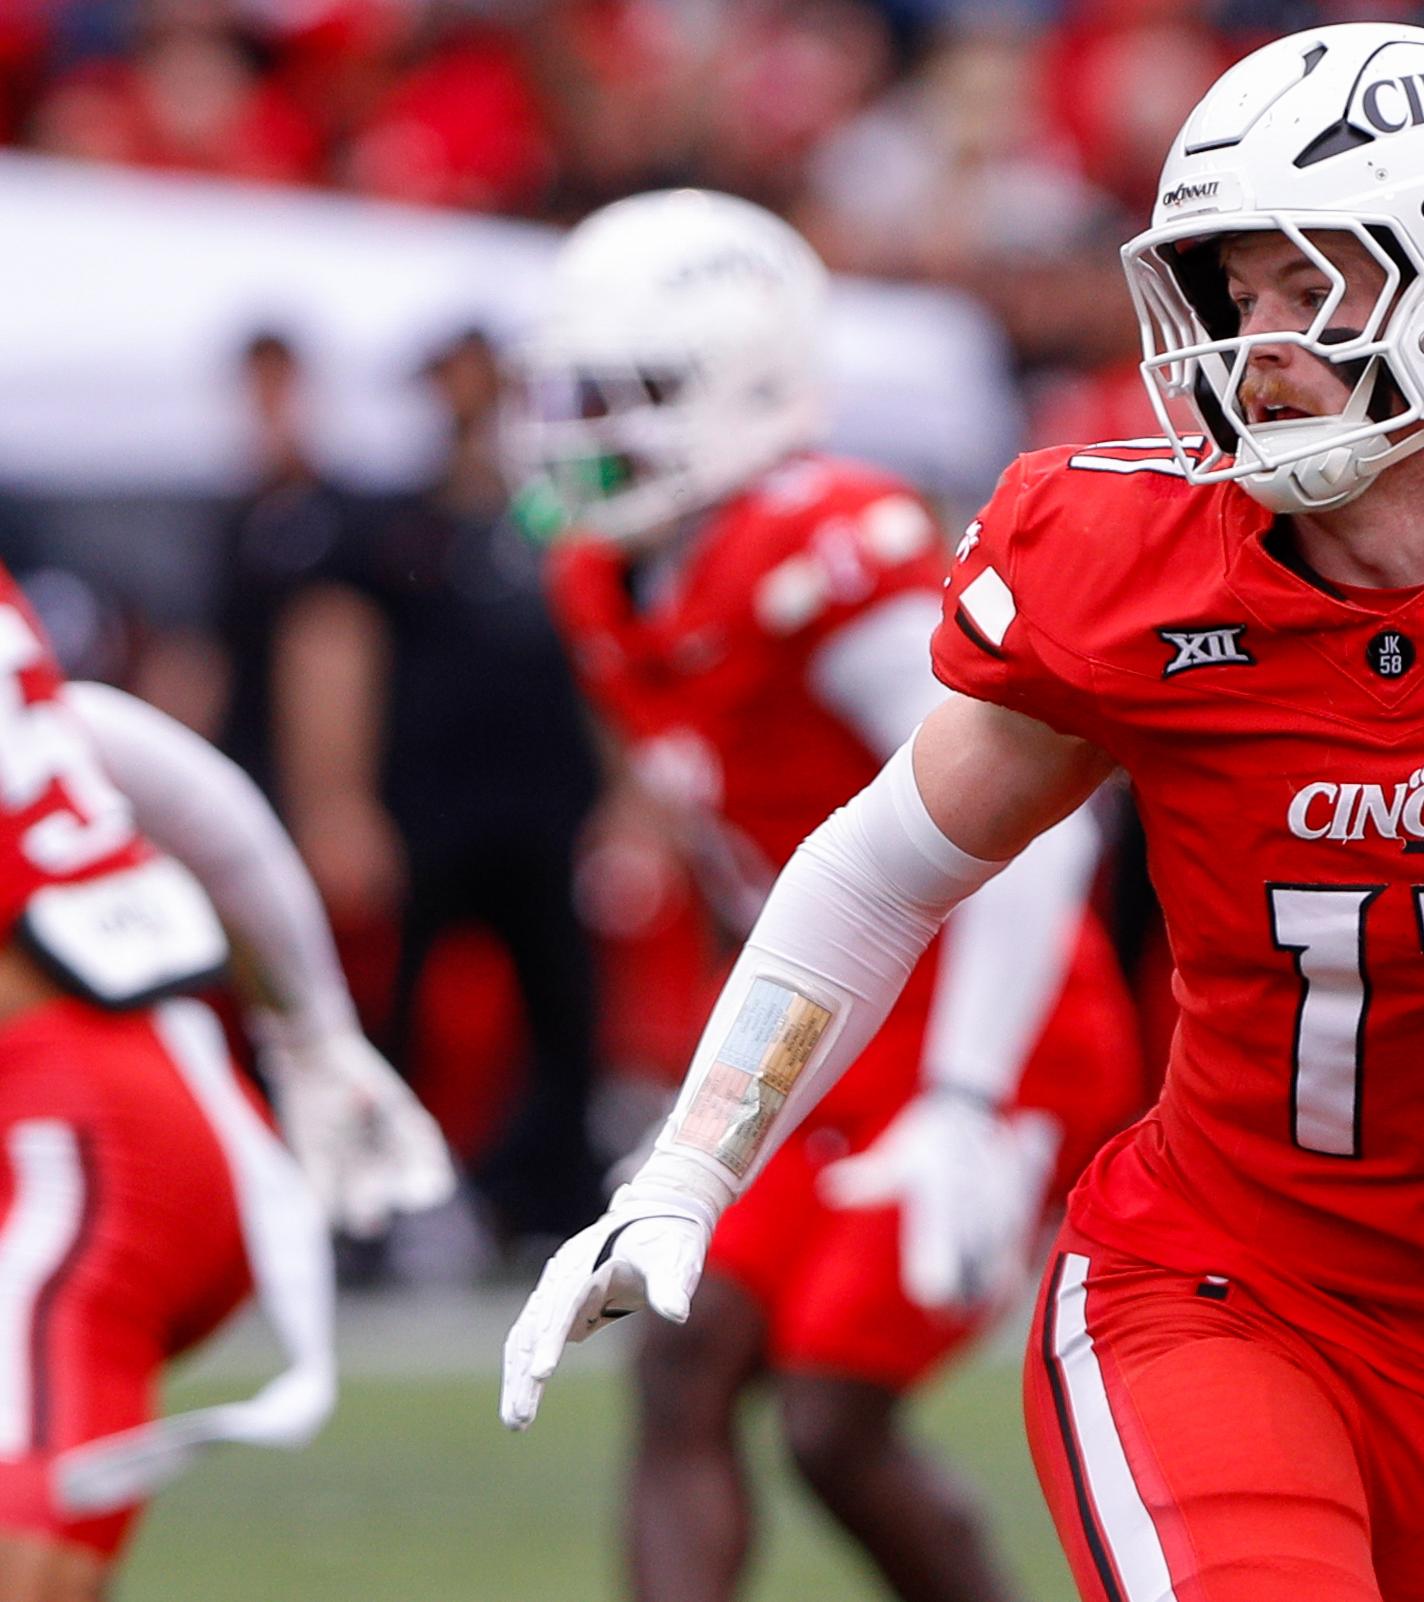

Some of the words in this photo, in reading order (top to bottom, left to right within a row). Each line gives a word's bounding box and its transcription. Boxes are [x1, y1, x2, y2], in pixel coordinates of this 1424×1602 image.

[1161, 628, 1249, 674] XII
[1379, 635, 1401, 654] JK
[1380, 656, 1402, 674] 58
